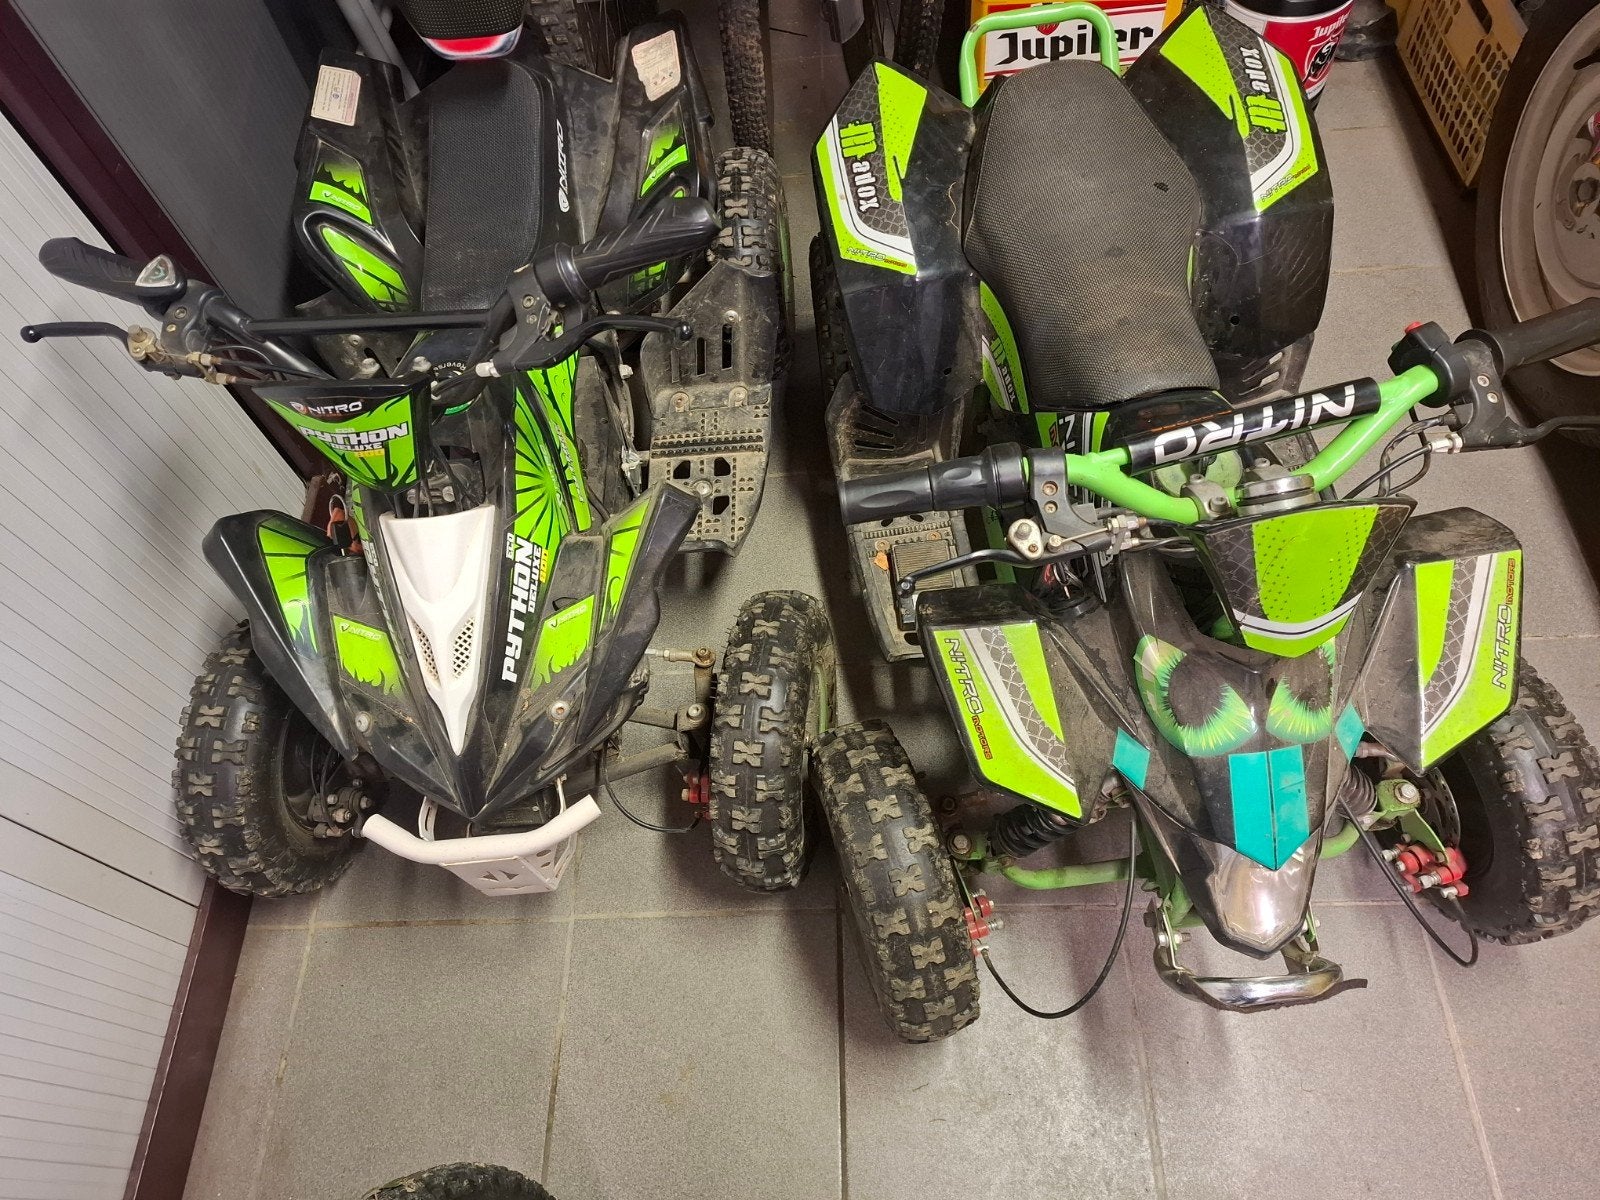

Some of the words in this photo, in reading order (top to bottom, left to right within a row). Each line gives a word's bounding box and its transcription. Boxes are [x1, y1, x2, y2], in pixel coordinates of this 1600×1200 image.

[297, 422, 409, 446] PYTHON
[308, 400, 363, 415] NITRO
[1154, 384, 1356, 465] NITRO
[505, 532, 516, 561] ECO
[527, 544, 542, 613] DELUXE
[501, 536, 534, 683] PYTHON
[944, 638, 985, 715] NITRO
[1491, 604, 1512, 690] NITRO
